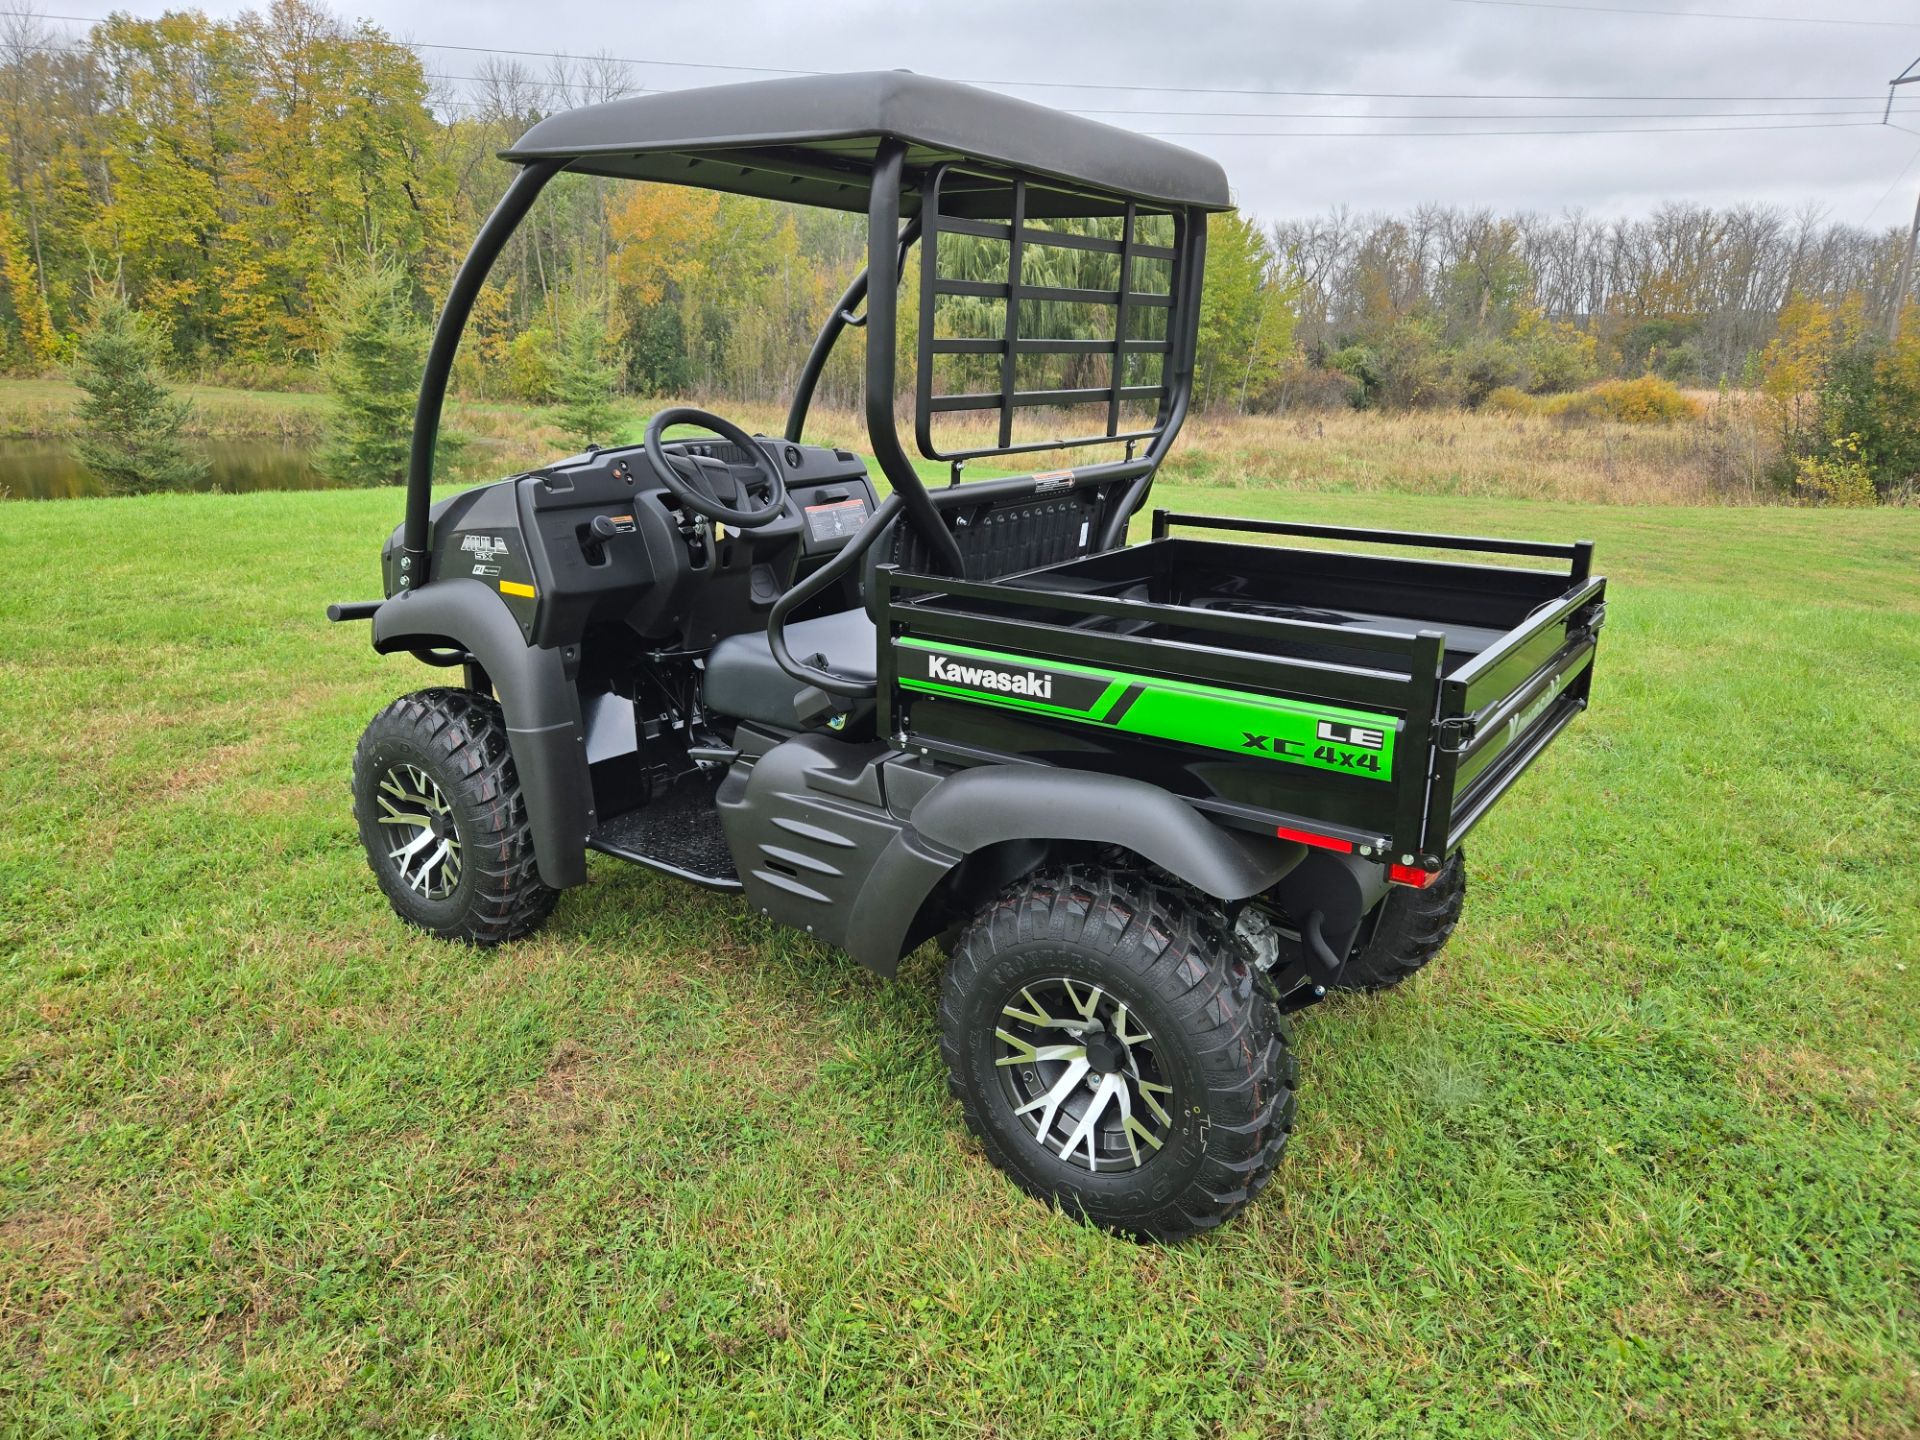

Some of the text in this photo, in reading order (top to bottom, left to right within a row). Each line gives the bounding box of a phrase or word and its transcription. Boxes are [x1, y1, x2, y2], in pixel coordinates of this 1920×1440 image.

[928, 654, 1052, 699] Kawasaki
[1241, 731, 1382, 773] XC 4x4
[1318, 721, 1383, 749] LE
